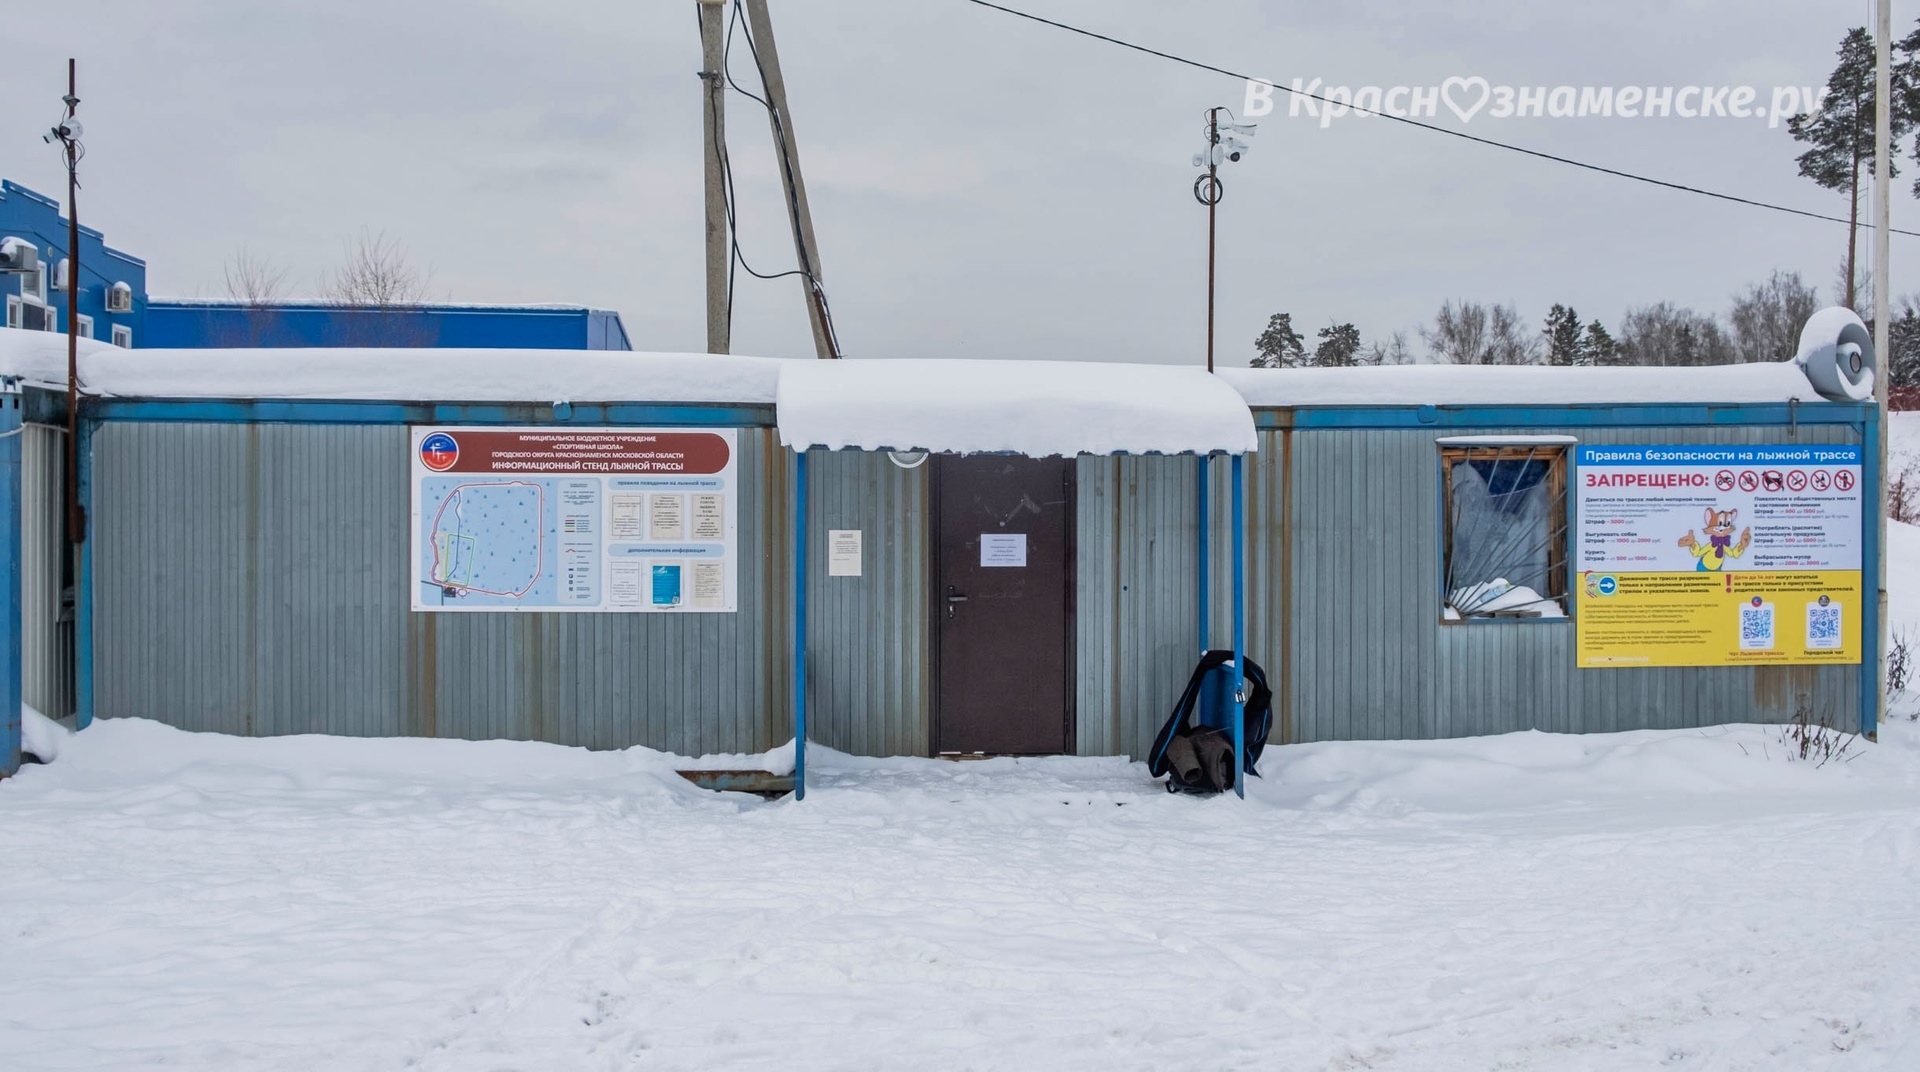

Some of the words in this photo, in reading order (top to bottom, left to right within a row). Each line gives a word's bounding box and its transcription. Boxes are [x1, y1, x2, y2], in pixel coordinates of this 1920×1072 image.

[1586, 450, 1642, 462] Правила
[1645, 450, 1734, 460] безопасности
[1738, 452, 1753, 460] на
[1756, 450, 1810, 460] лыжной
[1814, 452, 1856, 462] трассе
[492, 461, 580, 470] ИНФОРМАЦИОННЫЙ
[582, 461, 609, 470] СТЕНД
[610, 461, 650, 470] ЛЫЖНОЙ
[651, 461, 684, 470] ТРАССЫ
[1586, 474, 1709, 489] ЗАПРЕЩЕНО:
